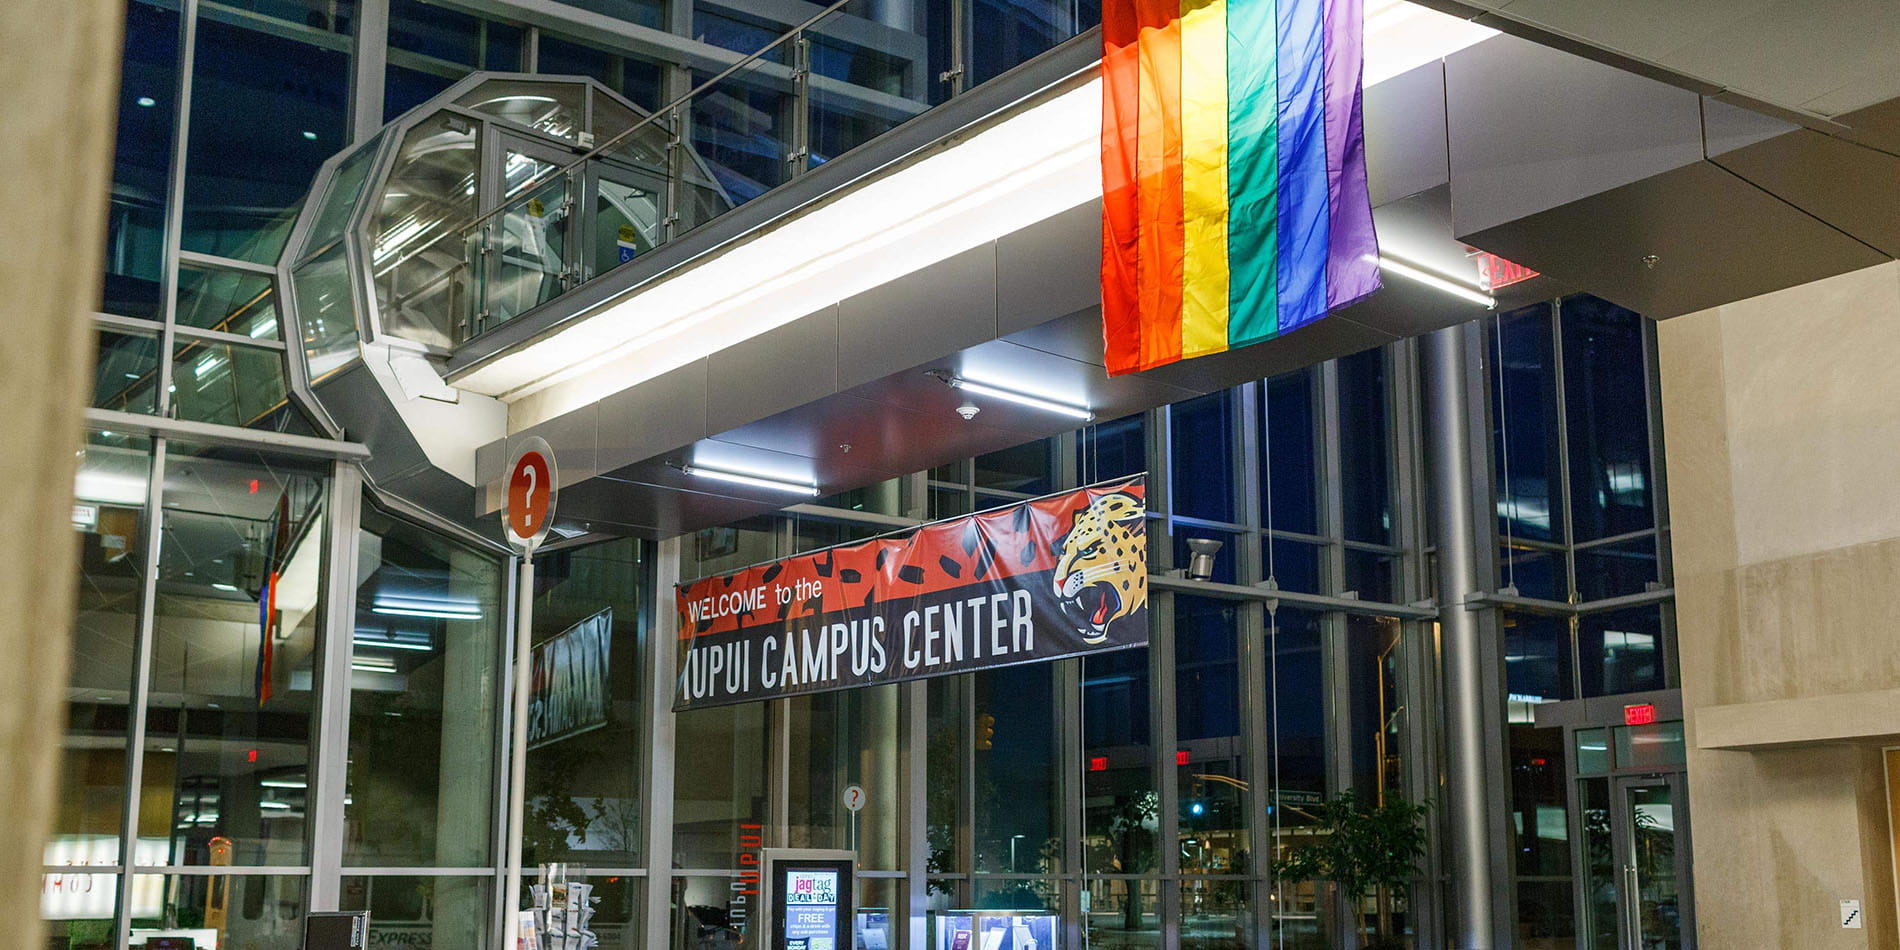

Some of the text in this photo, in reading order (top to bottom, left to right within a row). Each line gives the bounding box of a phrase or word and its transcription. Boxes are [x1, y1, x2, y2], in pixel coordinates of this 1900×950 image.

[1490, 254, 1530, 285] EXI
[688, 577, 823, 623] WELCOME to the
[683, 589, 1034, 701] IUPUI CAMPUS CENTER
[1629, 707, 1650, 723] EXIT
[739, 824, 761, 894] IUPUI
[795, 876, 832, 893] jagtag
[787, 892, 812, 902] DEAL
[817, 892, 835, 902] DAY
[798, 913, 825, 923] FREE
